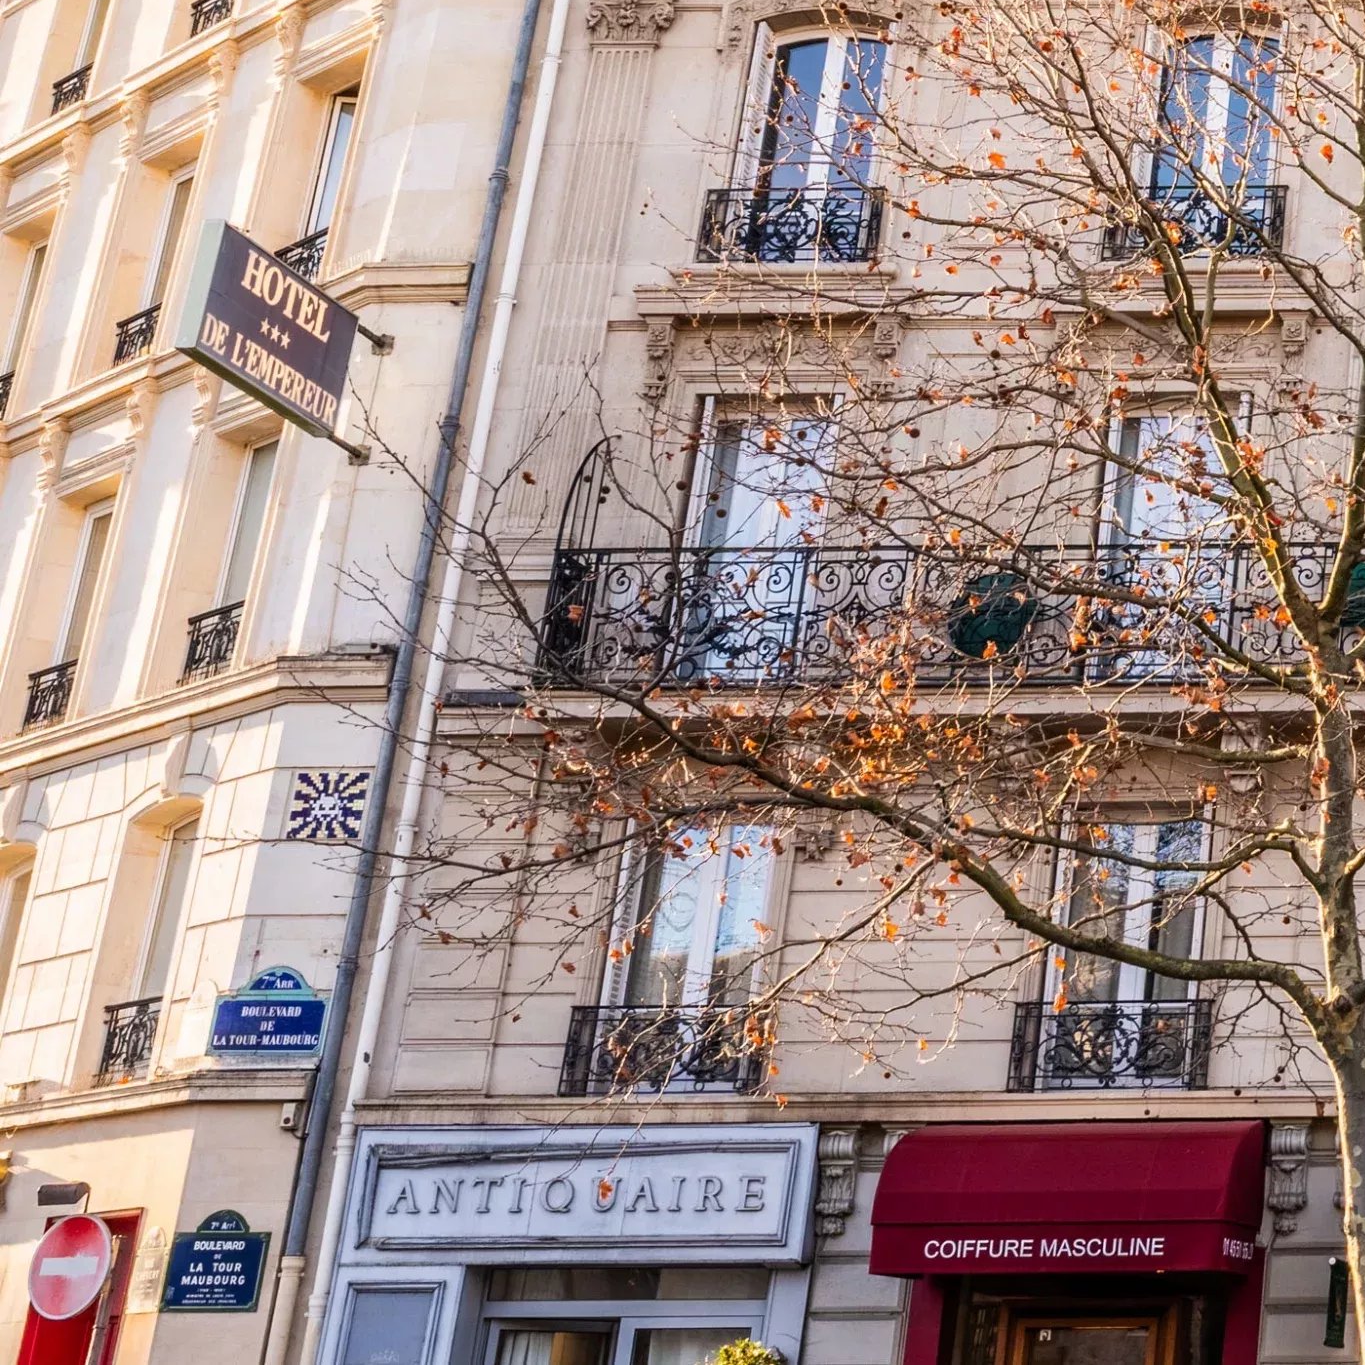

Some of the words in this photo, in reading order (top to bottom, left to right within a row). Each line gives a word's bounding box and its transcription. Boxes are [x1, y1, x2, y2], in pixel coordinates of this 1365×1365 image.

[241, 249, 330, 343] HOTEL
[201, 313, 229, 356] DE
[231, 332, 338, 427] L'EMPEREUR
[241, 1006, 302, 1017] BOULEVARD
[260, 1021, 275, 1031] DE
[213, 1035, 226, 1045] LA
[229, 1034, 319, 1046] TOUR-MAUBOURG
[386, 1175, 768, 1214] ANTIQUAIRE
[193, 1241, 245, 1250] BOULEVARD
[924, 1239, 1034, 1258] COIFFURE
[1039, 1237, 1165, 1258] MASCULINE
[189, 1263, 203, 1272] LA
[212, 1263, 242, 1272] TOUR
[181, 1275, 245, 1285] MAUBOURG
